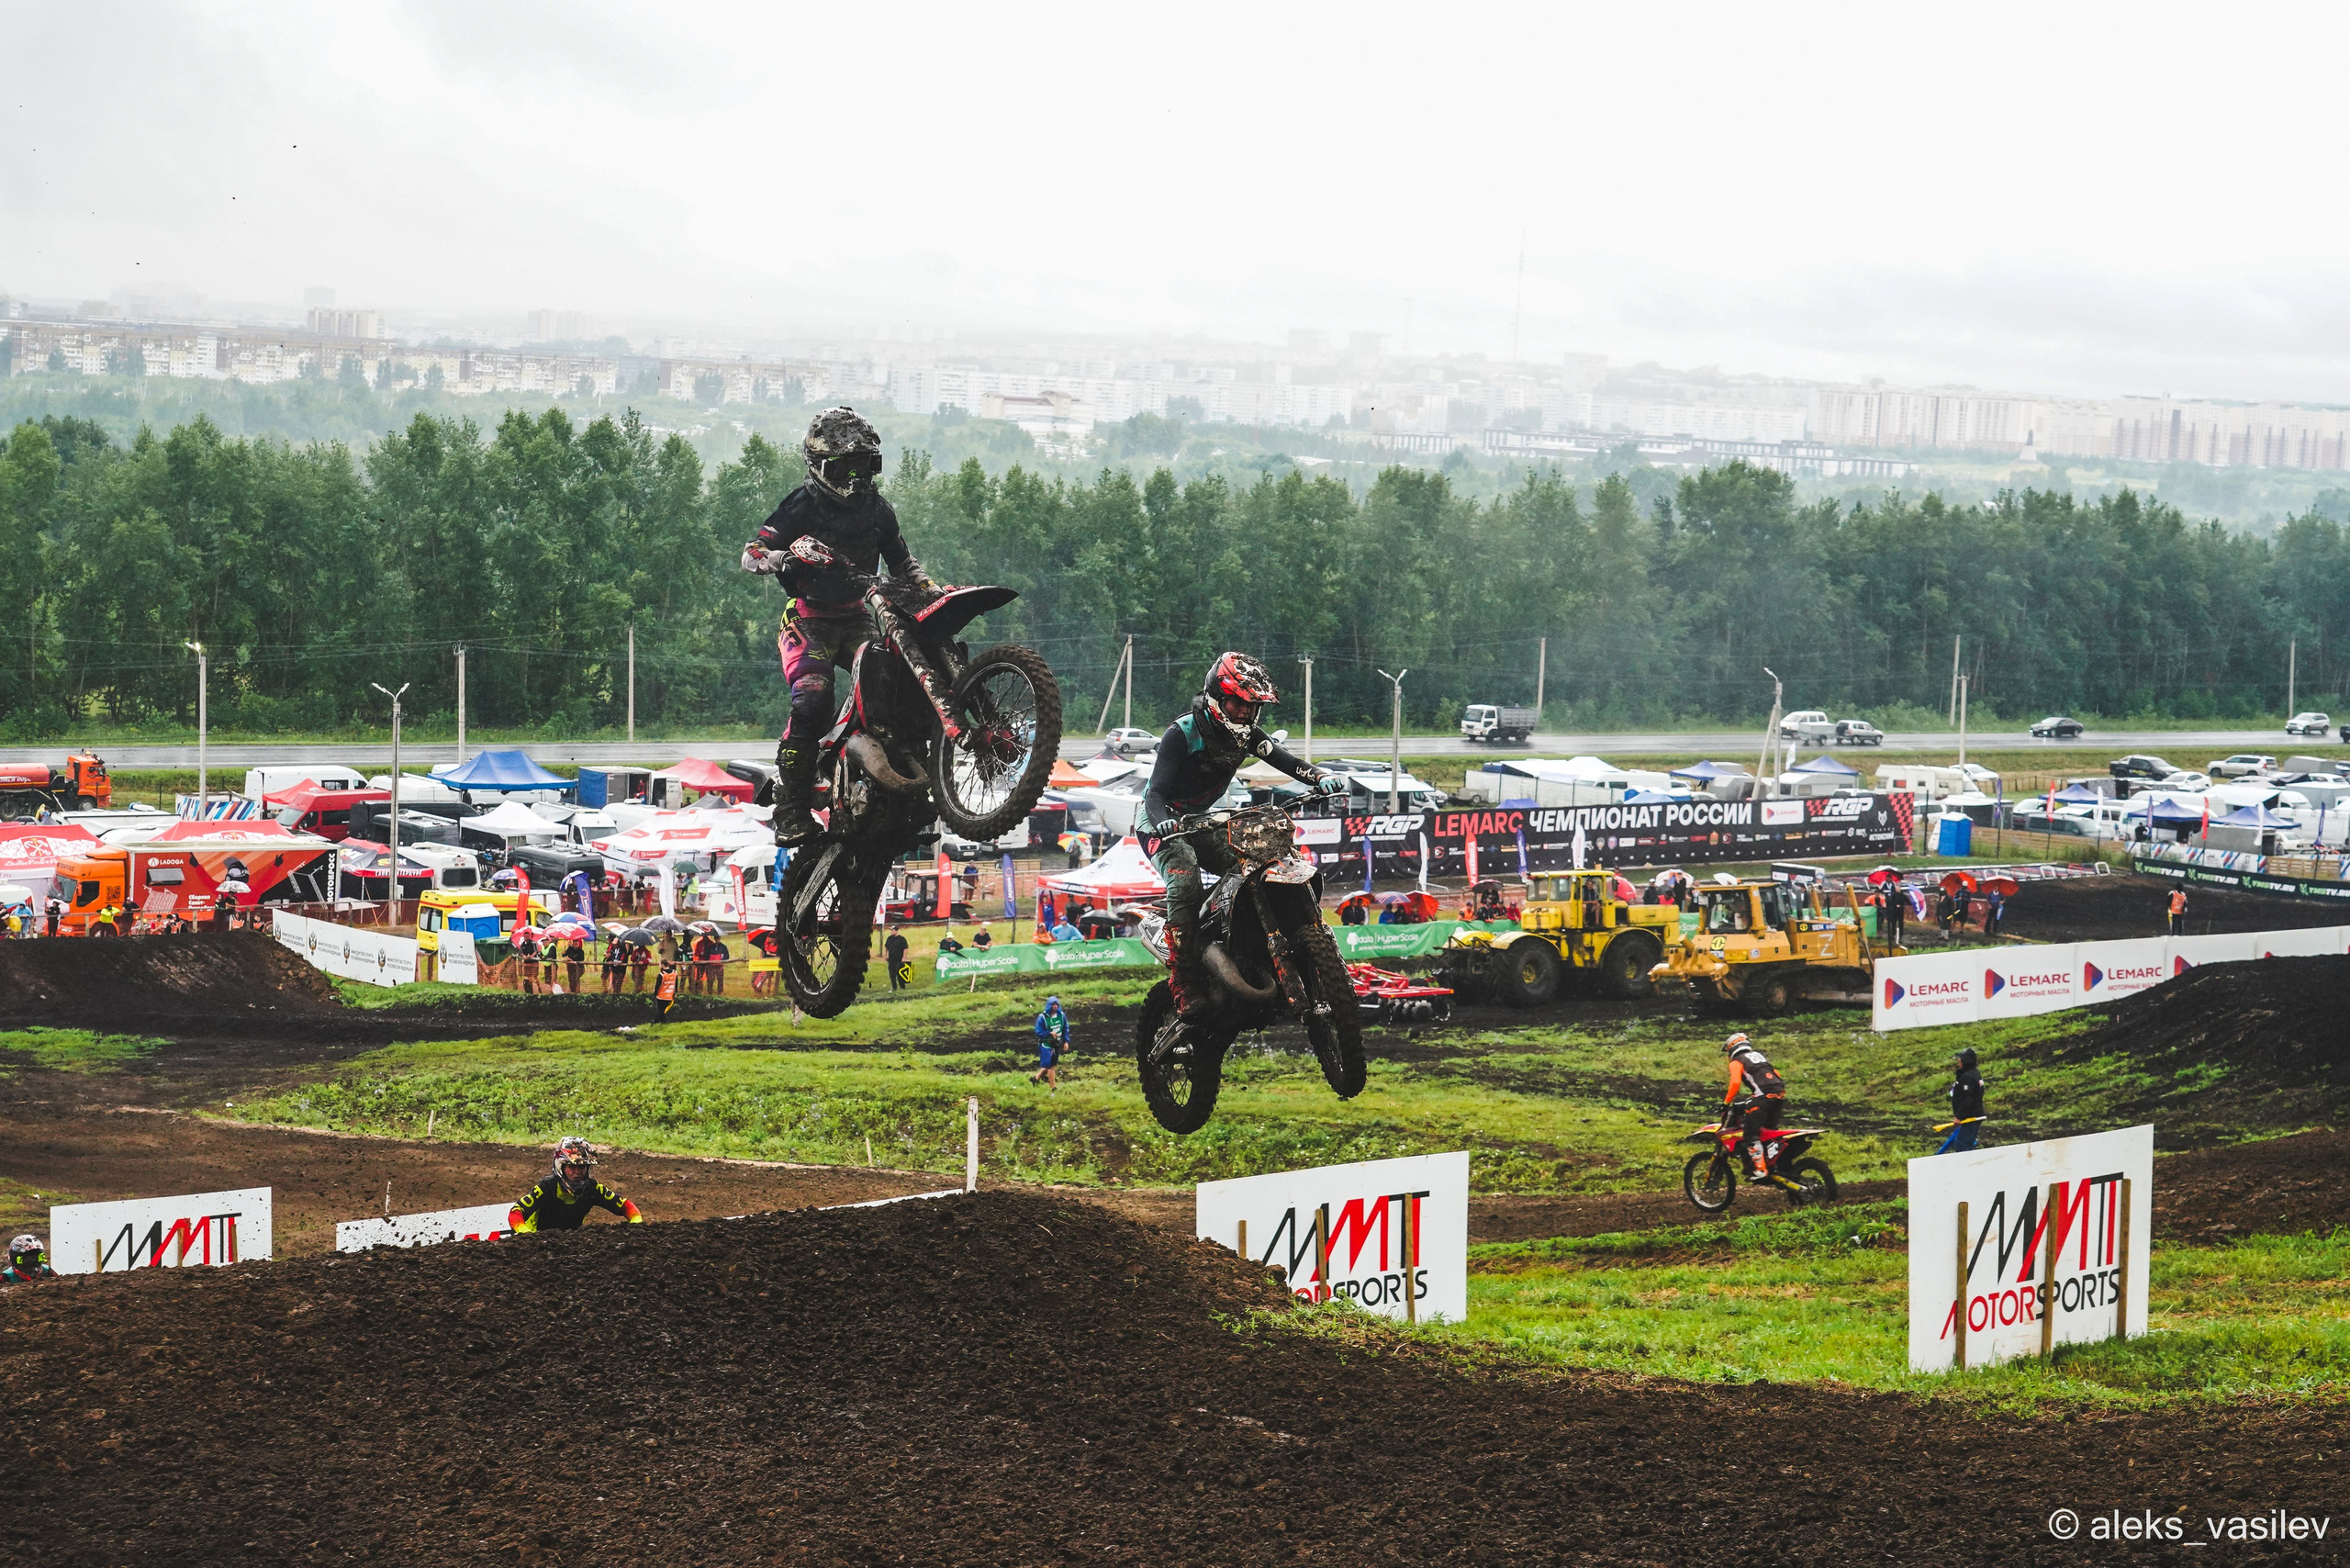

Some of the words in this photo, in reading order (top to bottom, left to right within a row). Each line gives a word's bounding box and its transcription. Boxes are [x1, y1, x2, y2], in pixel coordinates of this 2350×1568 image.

[1822, 797, 1874, 816] RGP
[1365, 814, 1426, 834] RGP
[1434, 812, 1524, 837] LEMARC
[1529, 804, 1662, 833] ЧЕМПИОНАТ
[1665, 803, 1752, 827] РОССИИ
[327, 853, 336, 902] МОТОКРОСС
[1378, 933, 1418, 944] HyperScale
[1079, 949, 1125, 961] HyperScale
[972, 956, 1019, 969] HyperScale
[2010, 973, 2071, 987] LEMARC
[2108, 967, 2163, 980] LEMARC
[1909, 981, 1969, 996] LEMARC
[2010, 990, 2046, 998] МОТОРНЫЕ
[1909, 998, 1945, 1008] МОТОРНЫЕ
[1946, 997, 1969, 1005] МАСЛА
